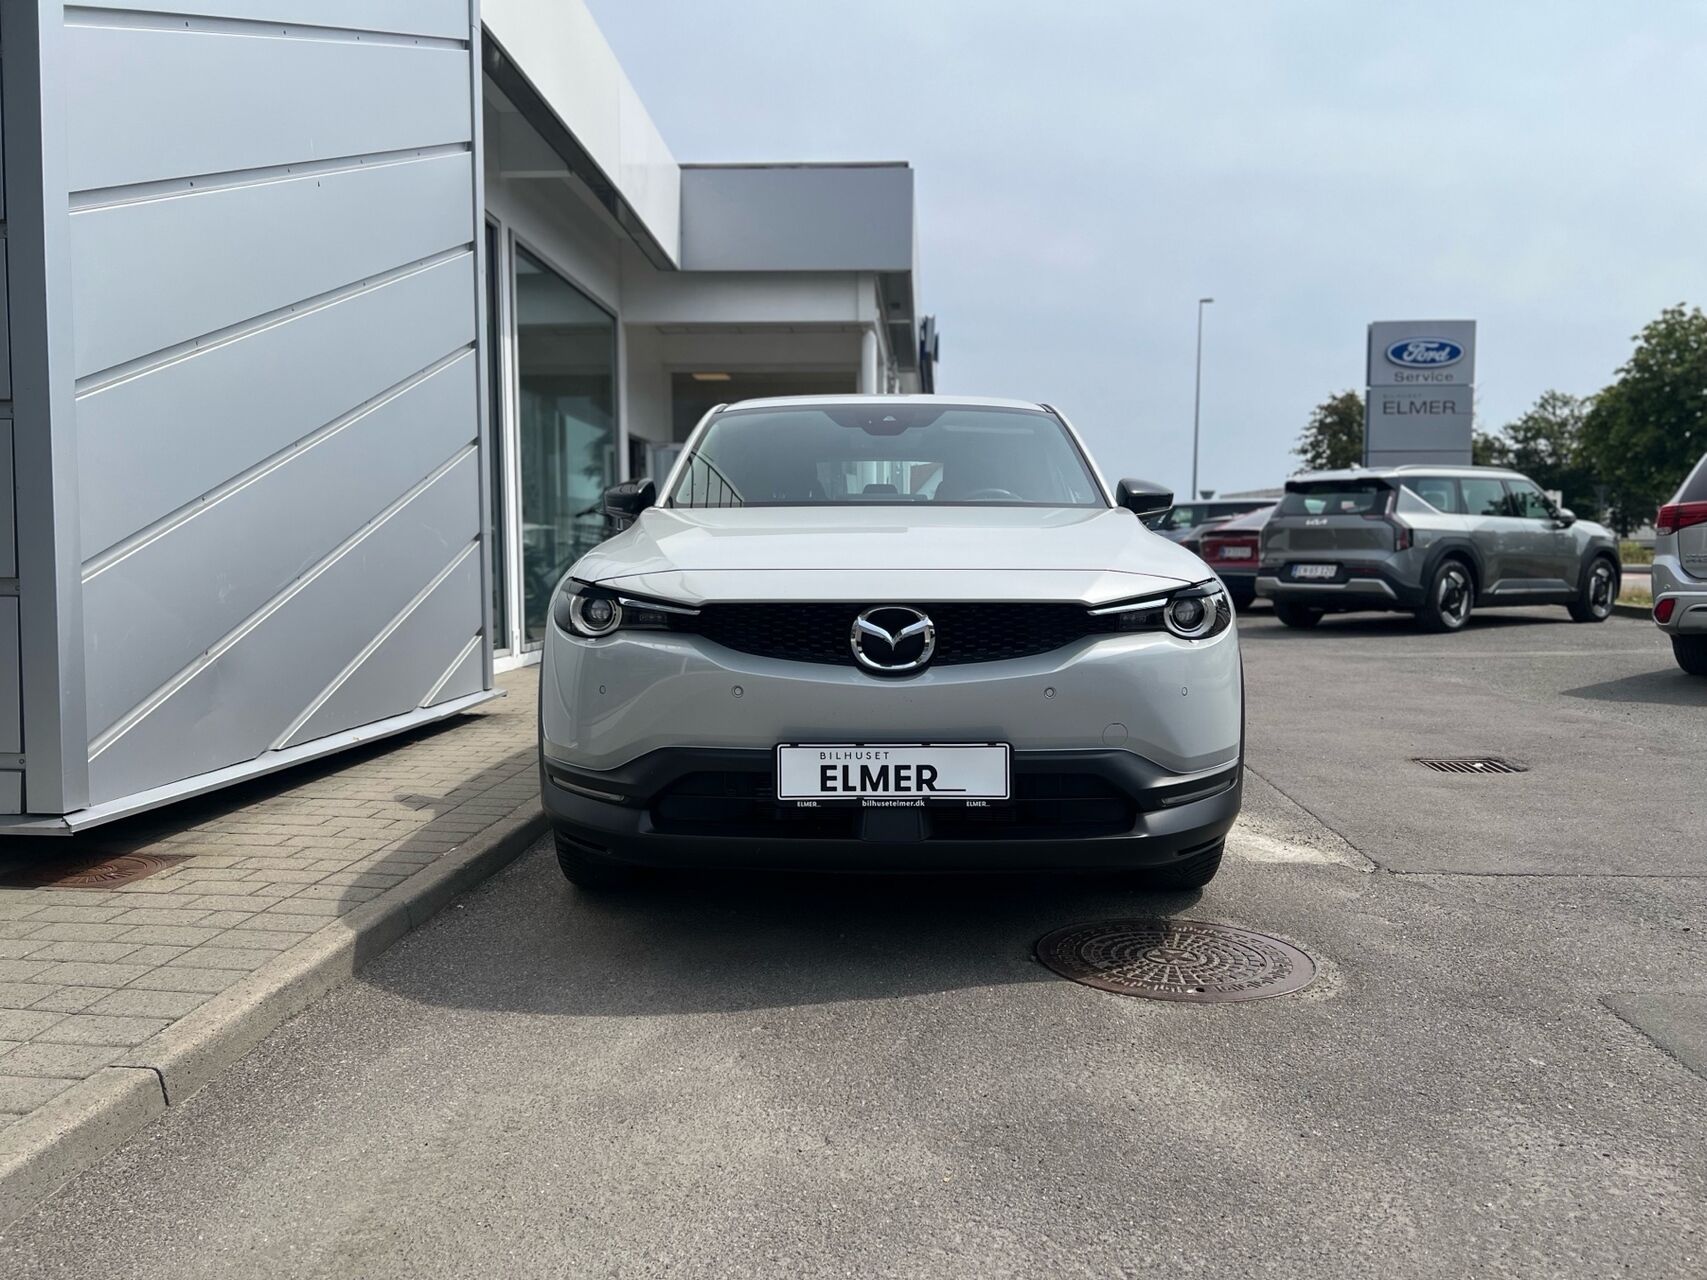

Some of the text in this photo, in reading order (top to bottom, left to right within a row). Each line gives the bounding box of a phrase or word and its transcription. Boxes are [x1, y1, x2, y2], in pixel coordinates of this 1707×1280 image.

[1402, 341, 1451, 362] Ford
[1394, 371, 1454, 383] Service
[1383, 400, 1456, 415] ELMER
[820, 752, 890, 760] BILHUSET
[820, 764, 938, 792] ELMER
[862, 800, 925, 808] bilhusetelmer.dk
